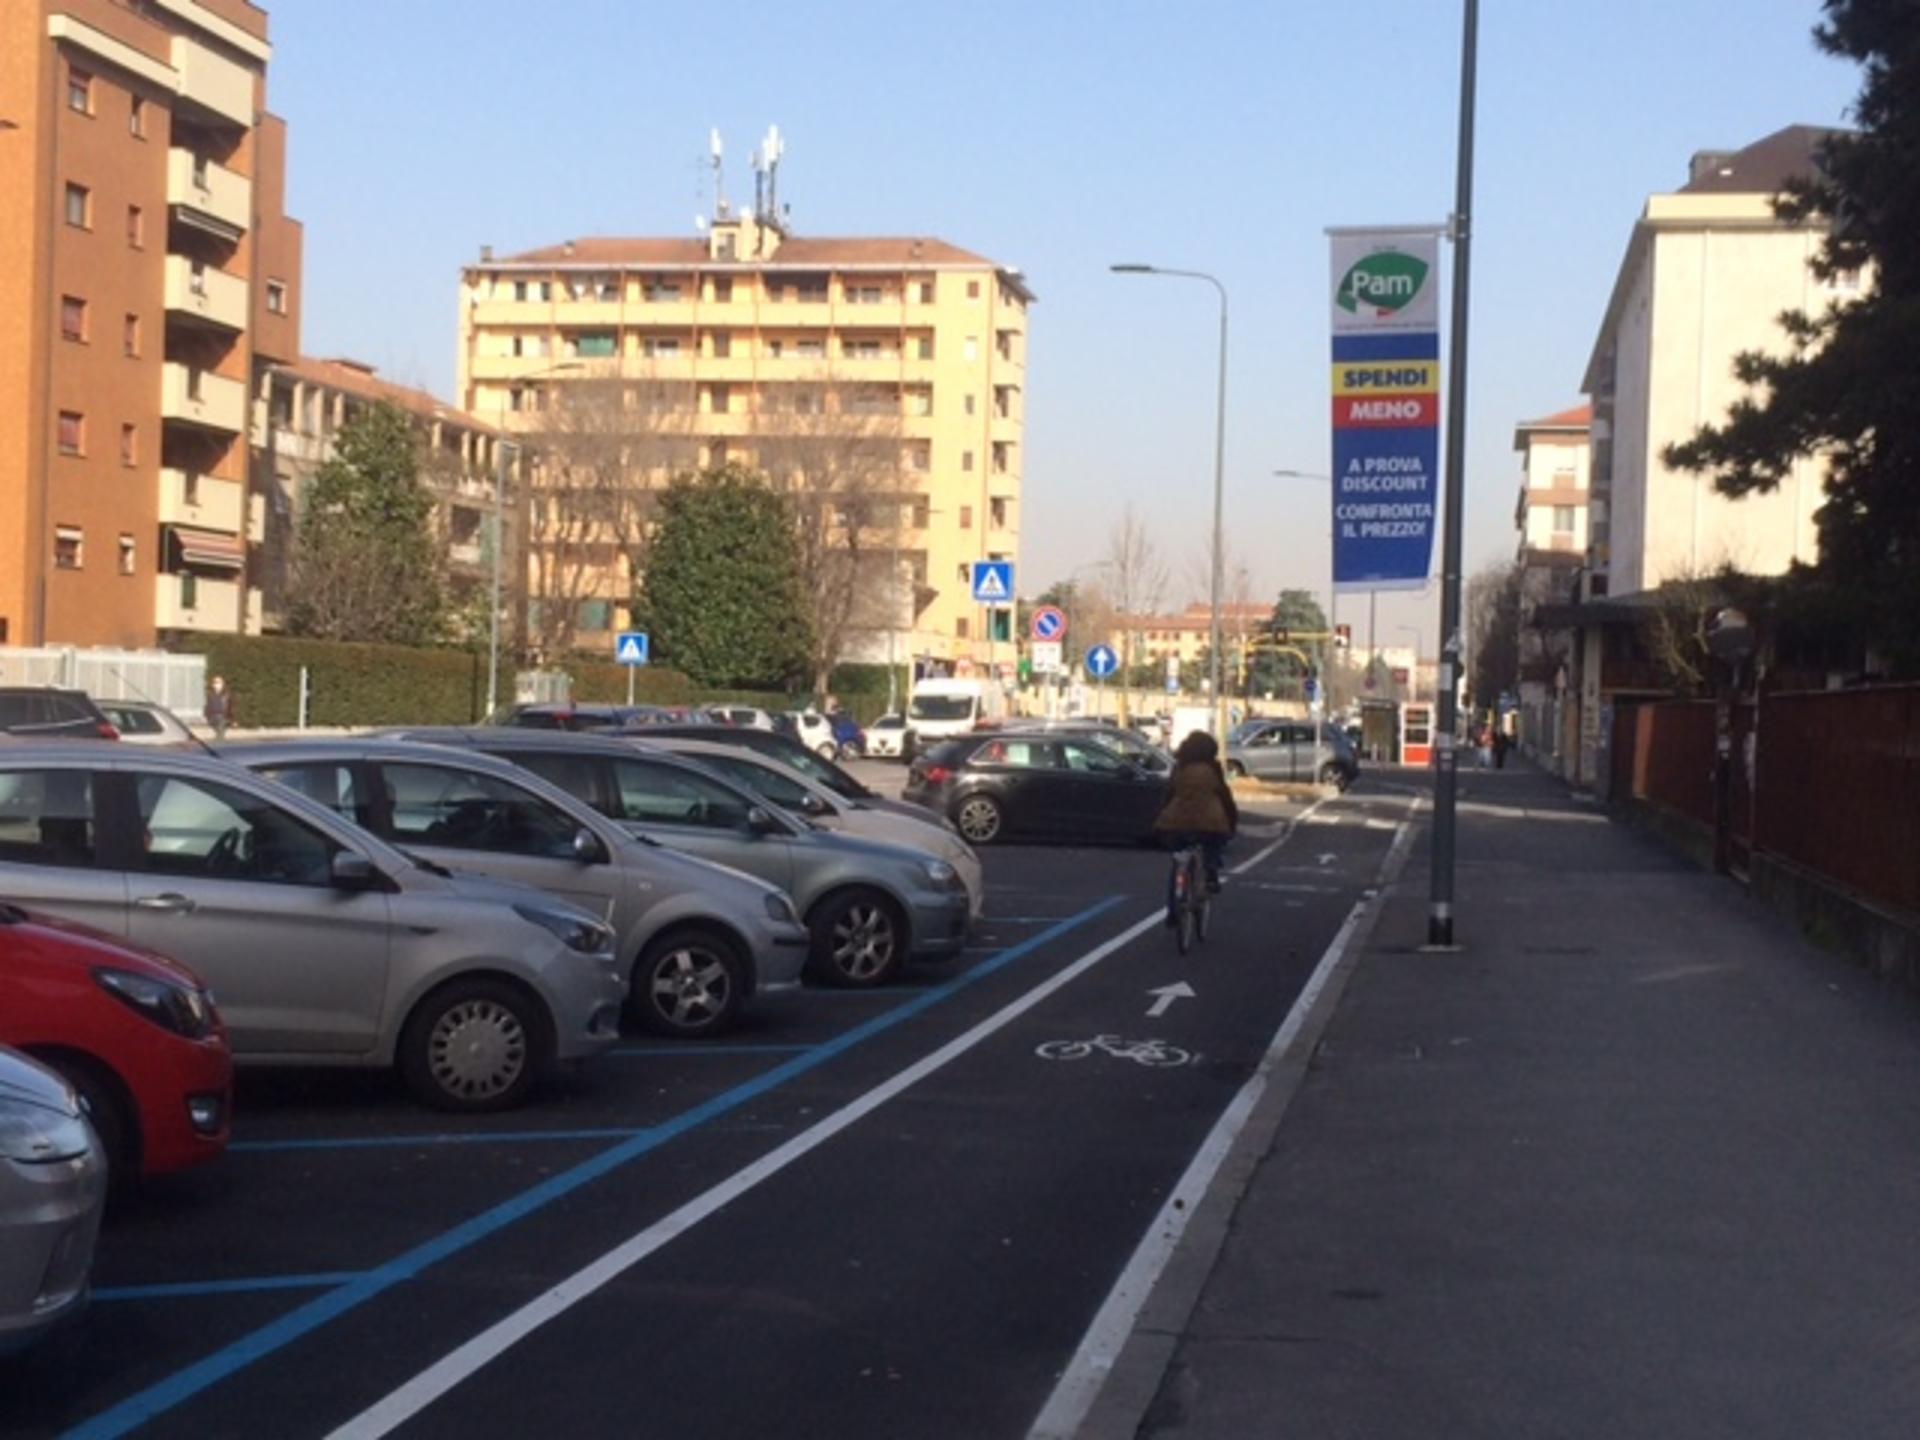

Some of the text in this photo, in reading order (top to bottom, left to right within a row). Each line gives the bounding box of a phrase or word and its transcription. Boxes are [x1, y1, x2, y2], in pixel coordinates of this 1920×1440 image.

[1351, 270, 1413, 296] Pam
[1344, 368, 1427, 387] SPENDI
[1350, 400, 1421, 420] MENO
[1349, 457, 1422, 472] A PROVA
[1342, 475, 1428, 491] DISCOUNT
[1337, 503, 1432, 519] CONFRONTA
[1343, 522, 1426, 537] IL PREZZO!
